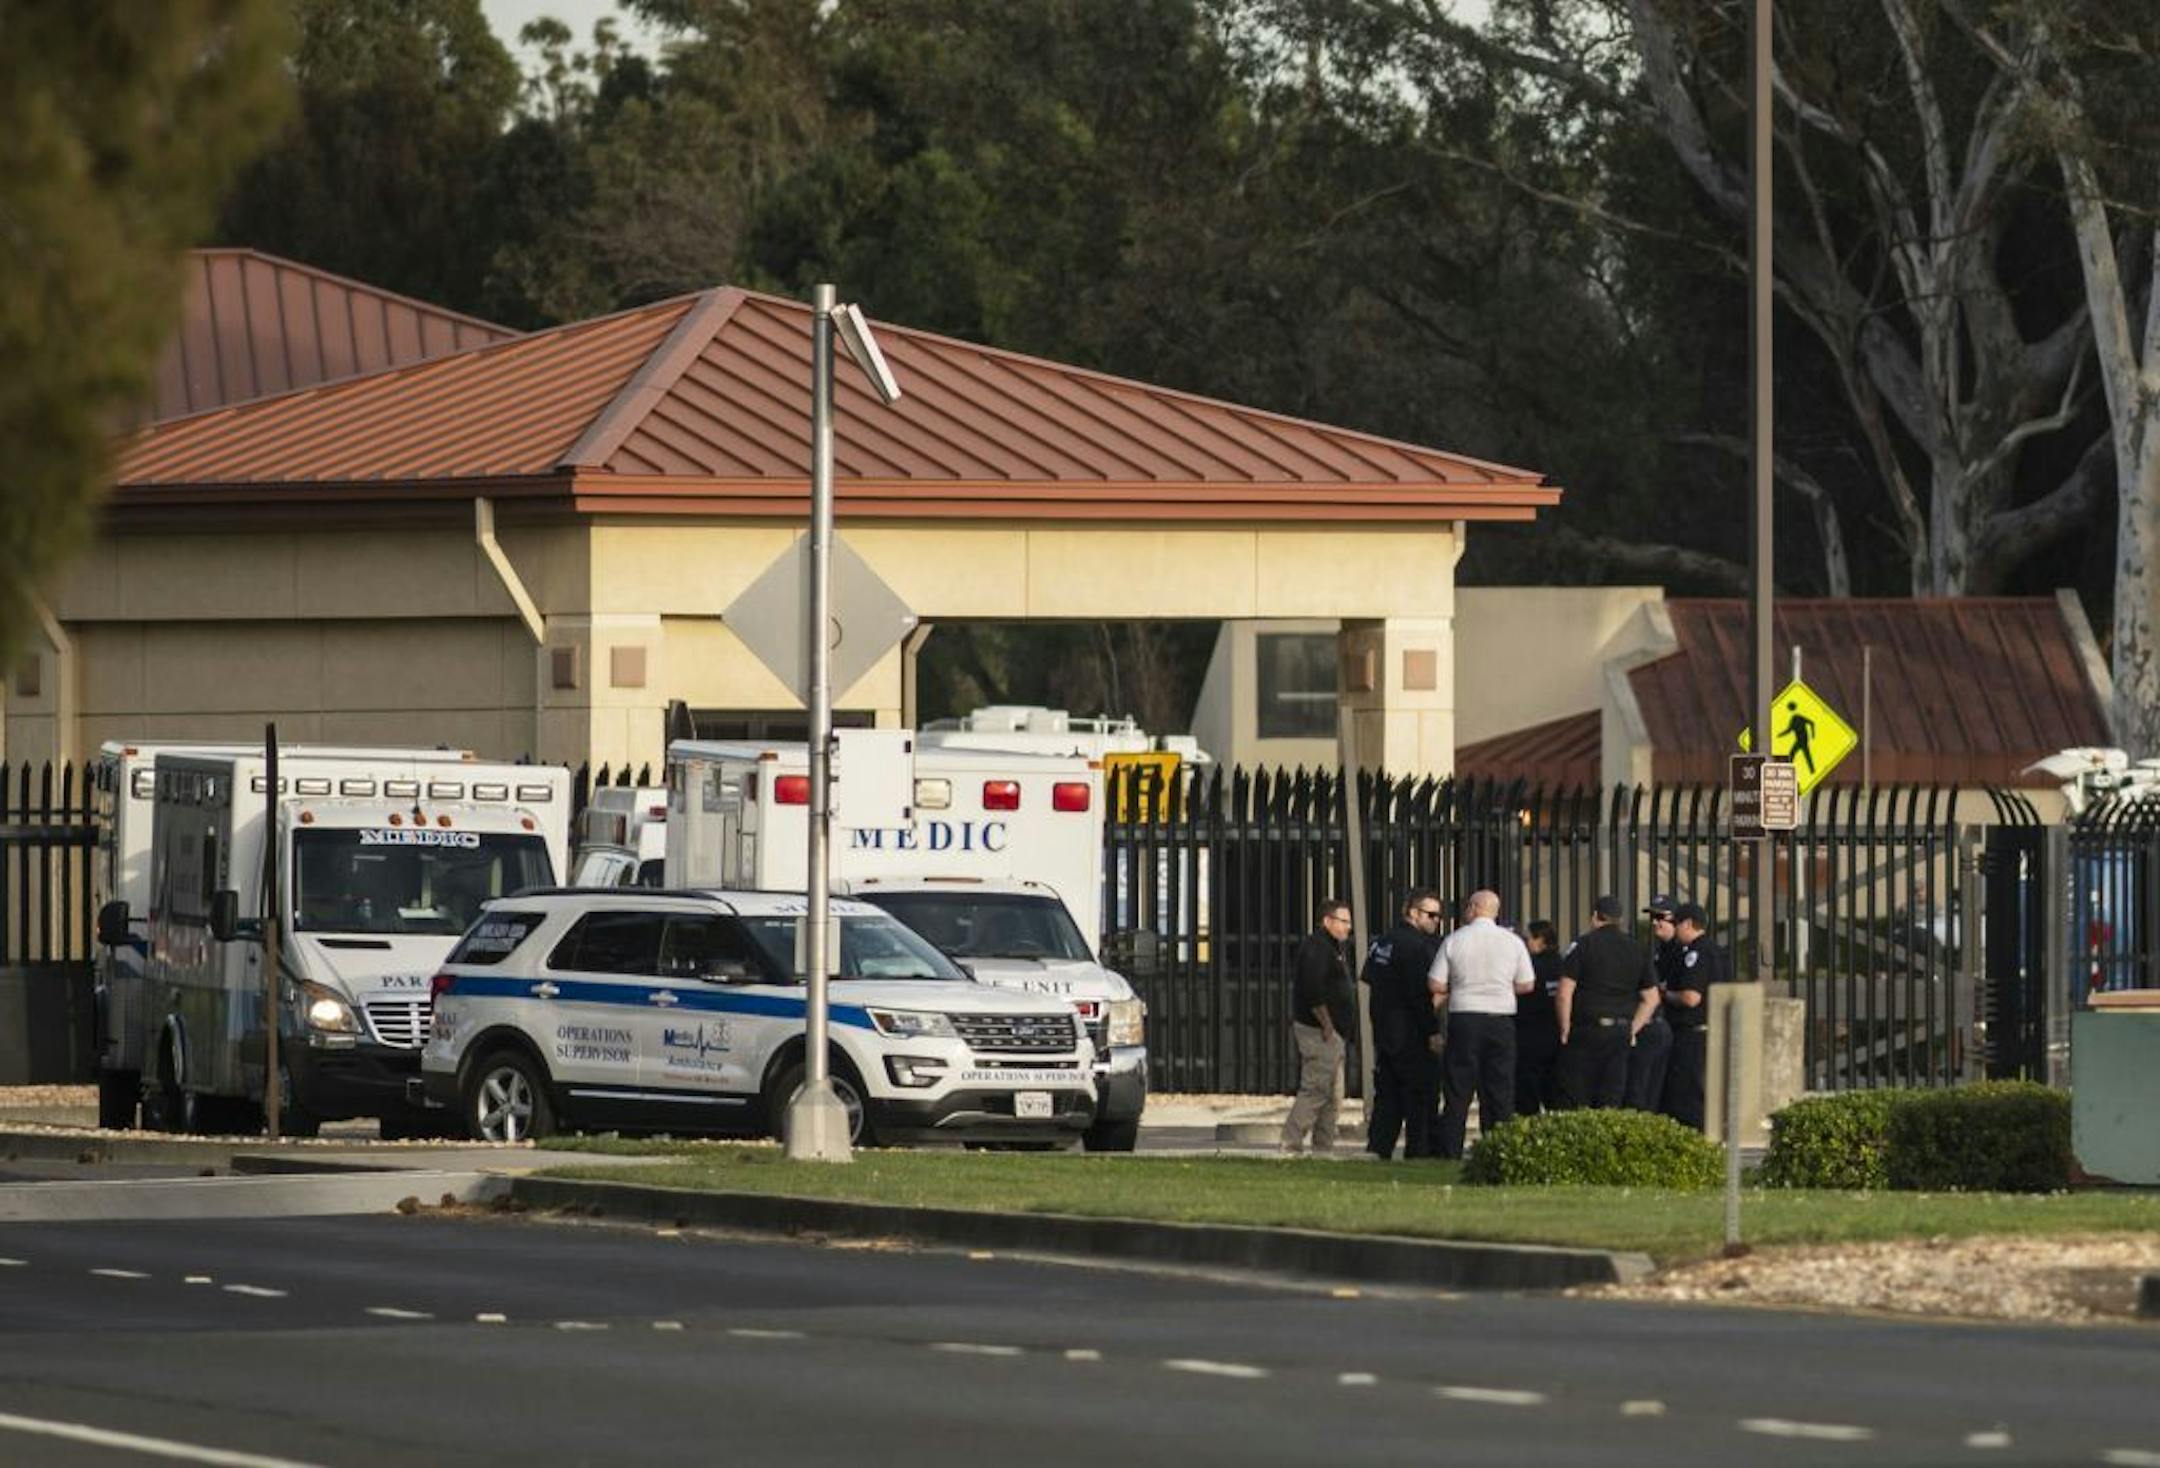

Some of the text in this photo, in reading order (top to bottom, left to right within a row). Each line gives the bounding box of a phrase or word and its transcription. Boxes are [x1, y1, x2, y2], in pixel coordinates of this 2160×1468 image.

[360, 828, 479, 849] MEDIC
[850, 821, 1006, 852] MEDIC
[1023, 981, 1073, 994] UNIT
[556, 1025, 632, 1045] OPERATIONS
[556, 1044, 632, 1064] SUPERVISOR
[961, 1070, 1030, 1081] OPERATIONS
